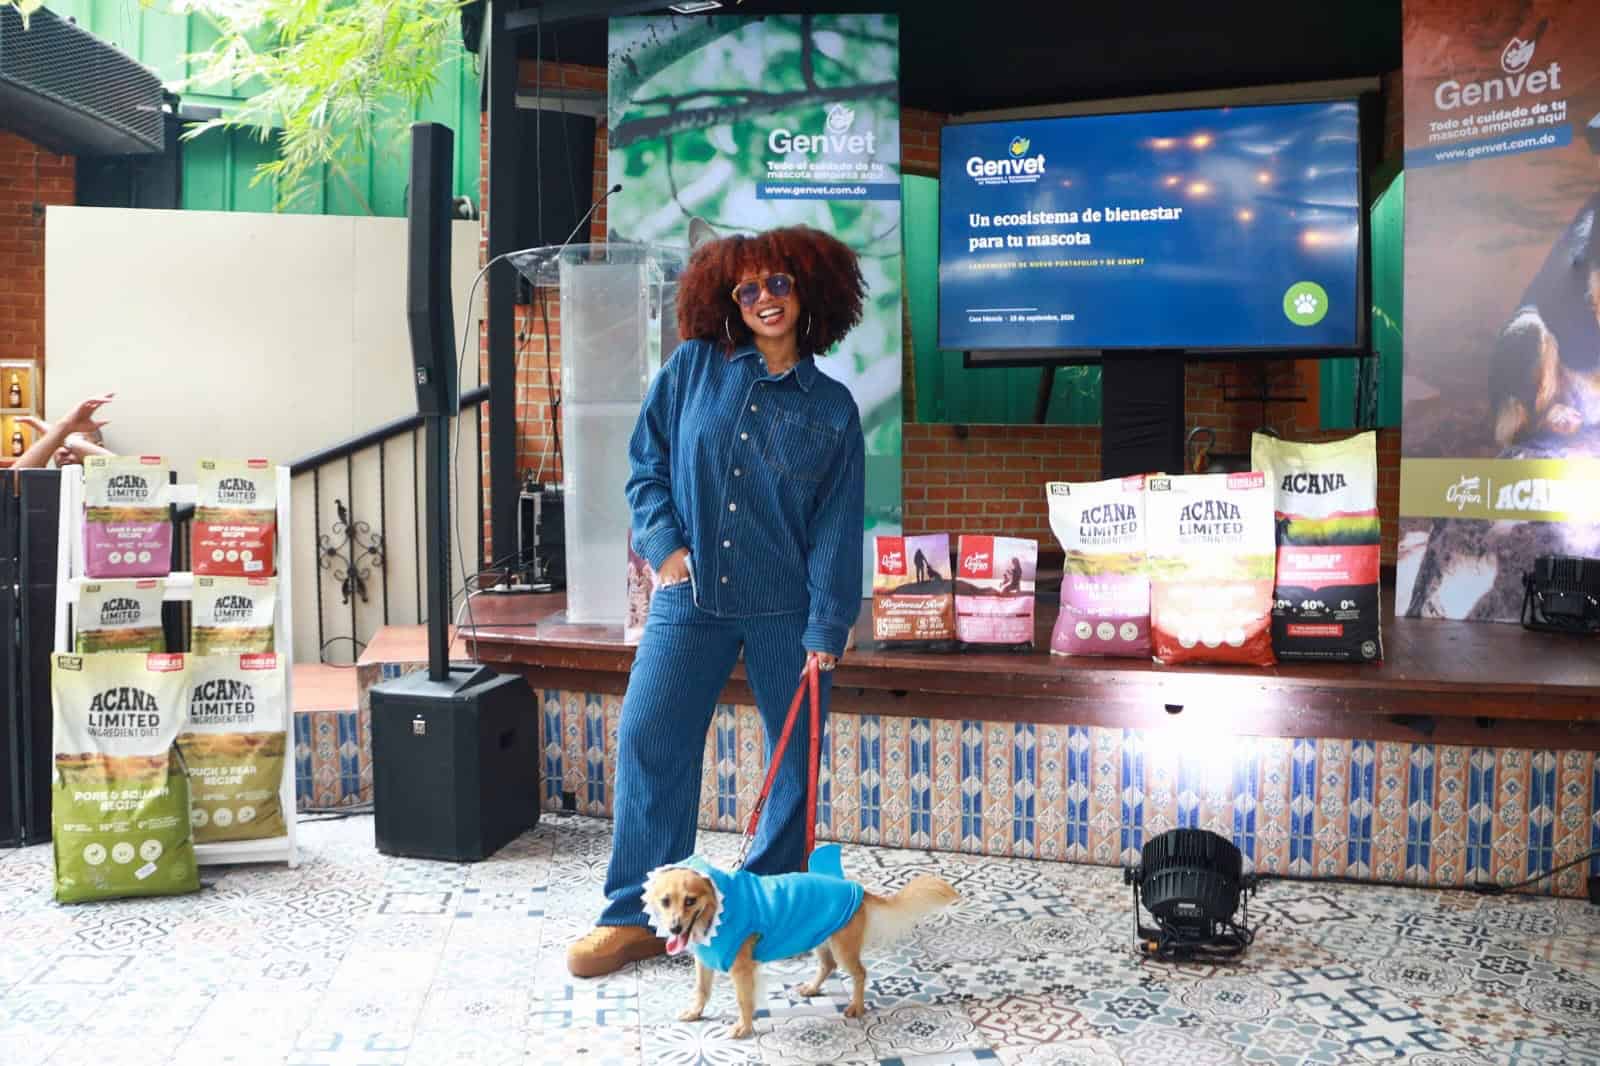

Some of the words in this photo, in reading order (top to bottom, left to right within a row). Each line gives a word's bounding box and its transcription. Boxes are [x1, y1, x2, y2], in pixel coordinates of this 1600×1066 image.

[1435, 61, 1562, 110] Genvet
[1430, 120, 1459, 132] Todo
[1462, 114, 1474, 125] el
[1476, 105, 1529, 124] cuidado
[1531, 103, 1549, 114] de
[1551, 100, 1567, 111] tu
[1428, 126, 1479, 143] mascota
[1481, 117, 1535, 134] empieza
[768, 128, 876, 154] Genvet
[1435, 133, 1556, 161] www.genvet.com.do
[966, 153, 1046, 177] Genvet
[765, 185, 867, 196] www.genvet.com.do
[969, 213, 990, 228] Un
[993, 210, 1079, 226] ecosistema
[1082, 208, 1101, 222] de
[1105, 206, 1183, 222] bienestar
[968, 236, 1003, 252] para
[1007, 234, 1023, 248] tu
[1026, 231, 1091, 247] mascota
[108, 475, 148, 488] ACANA
[219, 478, 255, 491] ACANA
[1281, 473, 1346, 494] ACANA
[107, 489, 148, 497] LIMITED
[218, 491, 256, 500] LIMITED
[1081, 504, 1137, 524] ACANA
[1180, 500, 1240, 521] ACANA
[1080, 522, 1137, 537] LIMITED
[1179, 522, 1243, 536] LIMITED
[102, 598, 140, 612] ACANA
[215, 595, 253, 609] ACANA
[1301, 600, 1325, 610] 40%
[1341, 600, 1356, 610] 0%
[101, 611, 140, 621] LIMITED
[192, 679, 255, 702] ACANA
[89, 687, 159, 712] ACANA
[191, 702, 255, 716] LIMITED
[89, 713, 160, 727] LIMITED
[87, 727, 138, 738] INGREDIENT
[74, 791, 108, 801] PORK
